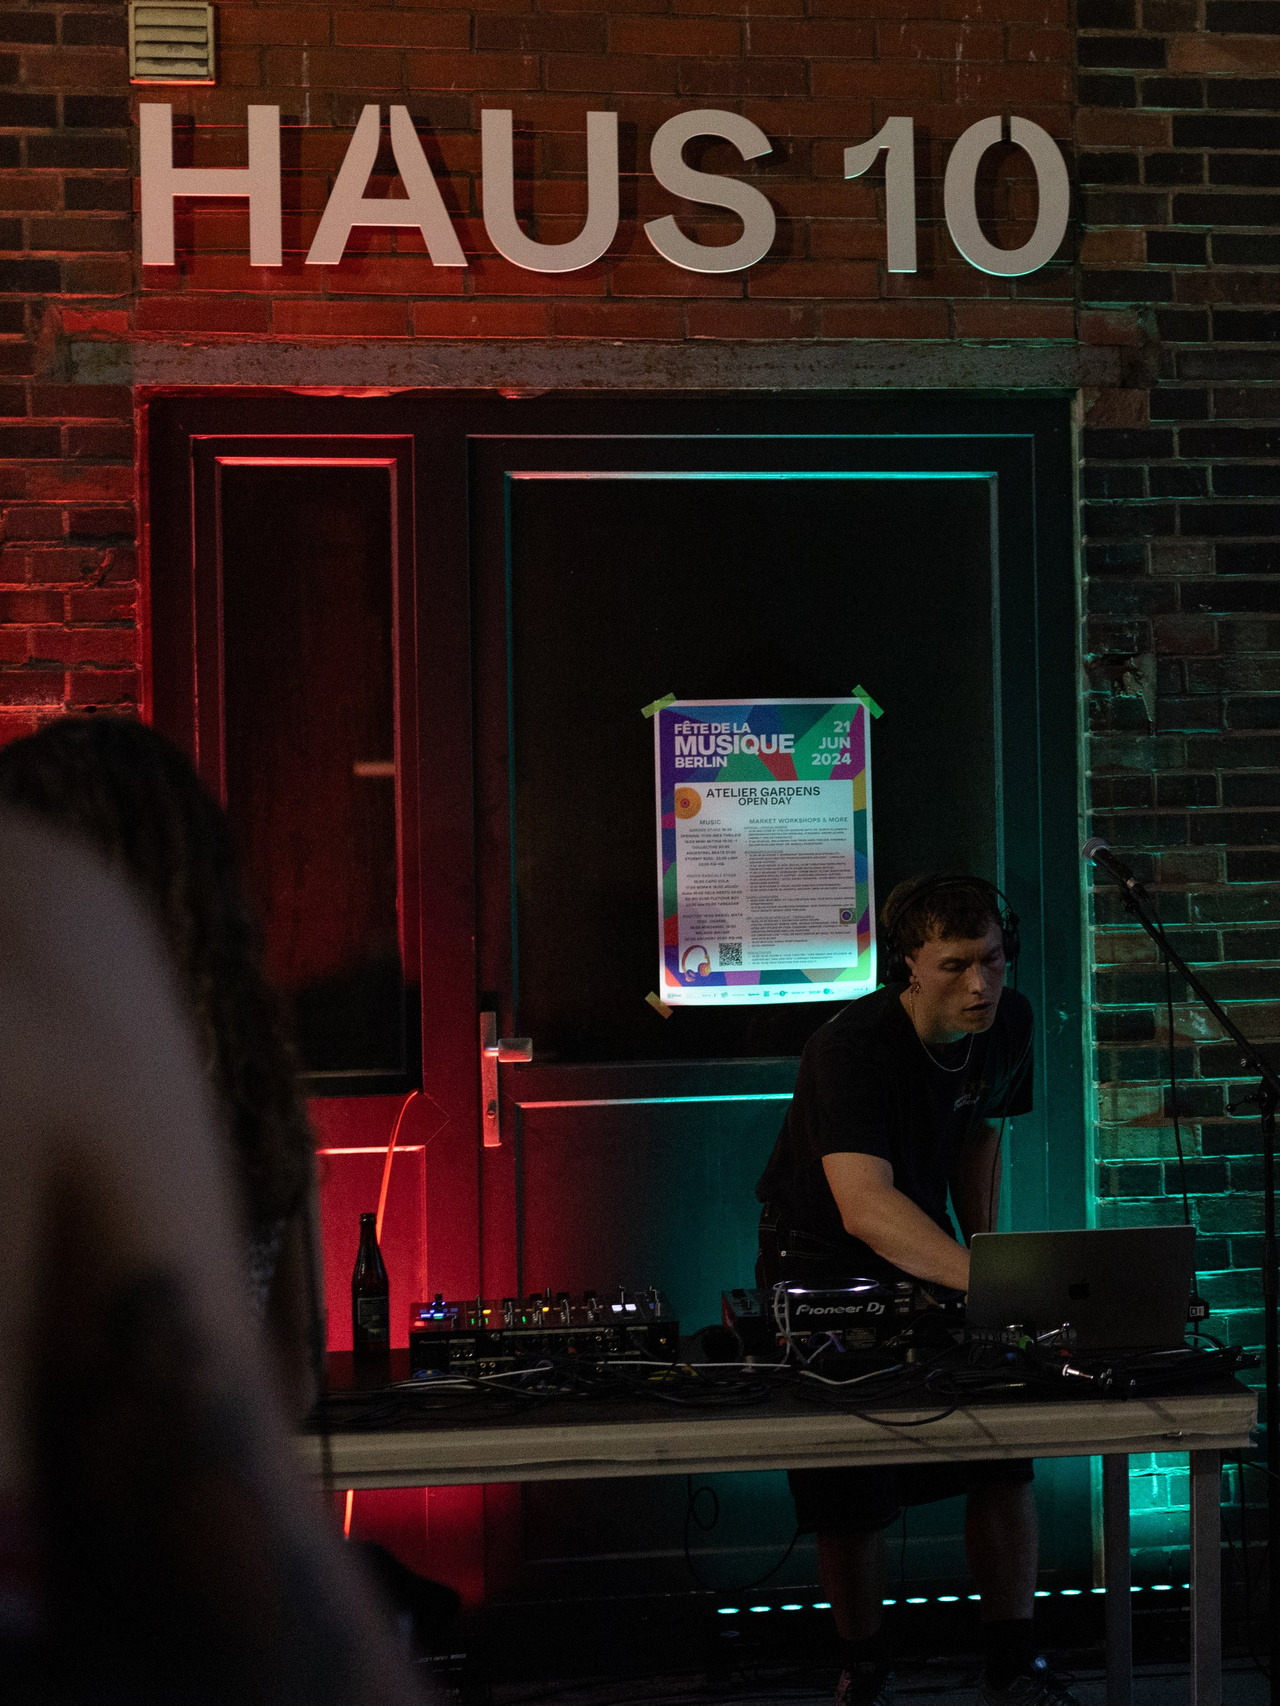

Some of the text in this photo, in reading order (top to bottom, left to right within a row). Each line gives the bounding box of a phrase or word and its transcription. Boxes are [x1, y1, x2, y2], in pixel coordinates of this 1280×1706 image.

[139, 102, 1070, 277] HAUS 10
[674, 720, 751, 734] FÊTE DE LA
[833, 720, 851, 733] 21
[674, 734, 795, 756] MUSIQUE
[818, 736, 851, 749] JUN
[675, 756, 728, 768] BERLIN
[811, 752, 852, 766] 2024
[706, 785, 821, 799] ATELIER GARDENS
[738, 796, 792, 806] OPEN DAY
[795, 1304, 864, 1316] Pioneer
